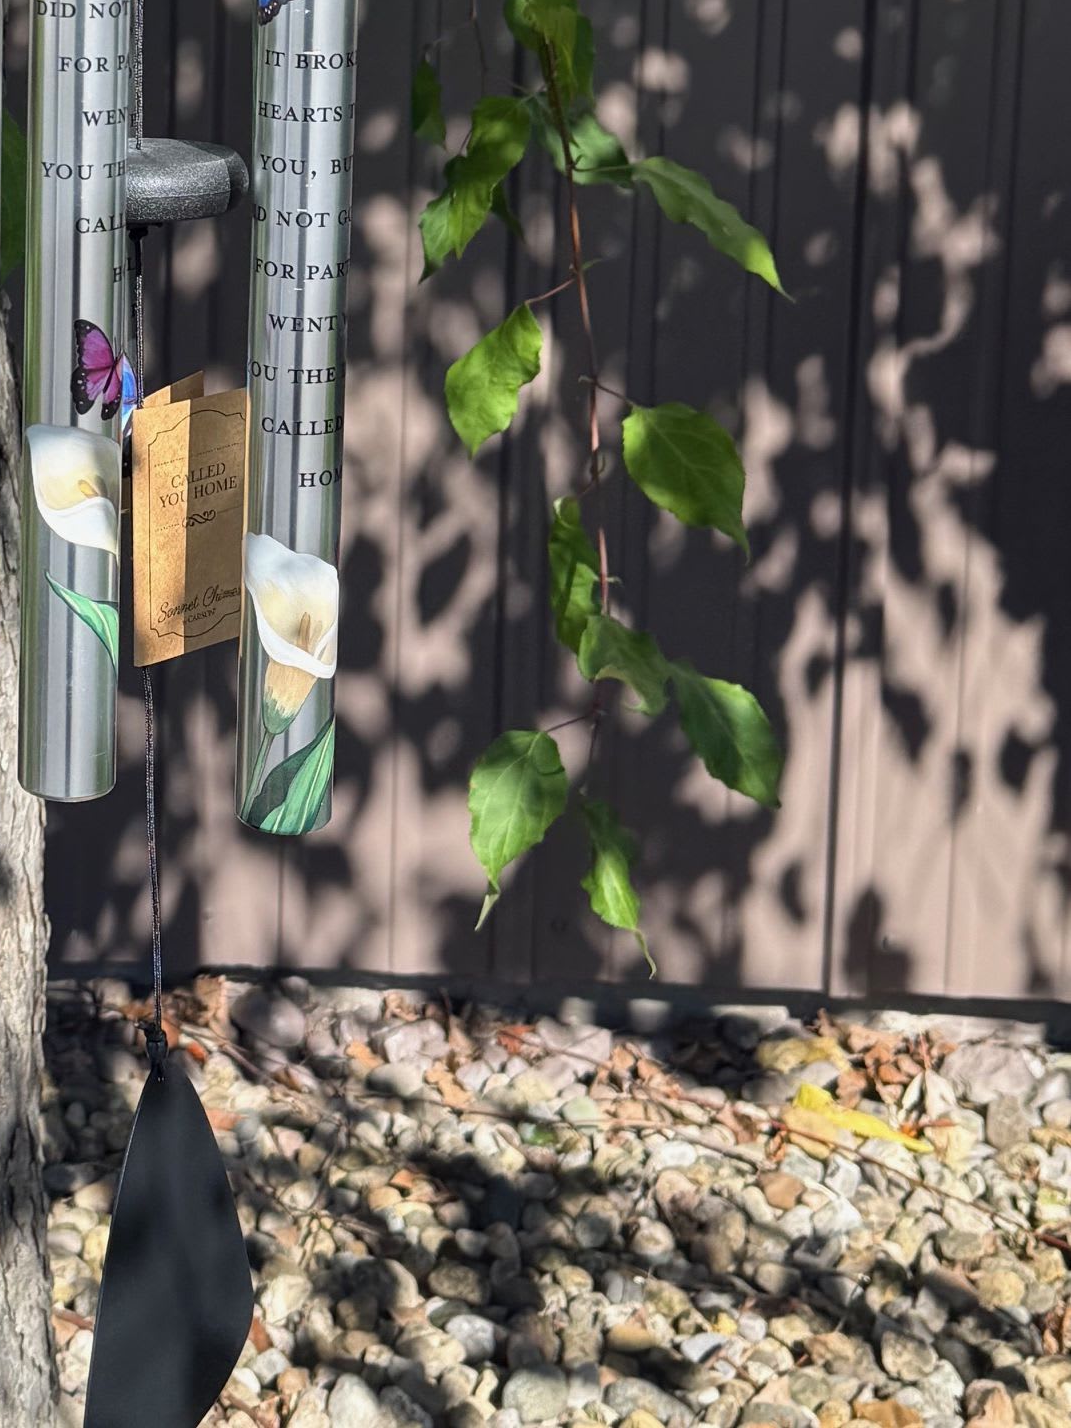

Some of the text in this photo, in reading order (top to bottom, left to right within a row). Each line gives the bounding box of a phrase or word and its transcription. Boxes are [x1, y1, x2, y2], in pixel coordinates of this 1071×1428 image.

[36, 0, 76, 18] DID
[58, 56, 109, 73] FOR
[265, 49, 285, 67] IT
[258, 100, 343, 122] HEARTS
[41, 161, 94, 181] YOU
[260, 153, 317, 180] YOU,
[275, 209, 330, 228] NOT
[255, 258, 295, 280] FOR
[268, 313, 338, 333] WENT
[287, 367, 337, 385] THE
[261, 415, 344, 436] CALLED
[194, 475, 238, 500] HOME
